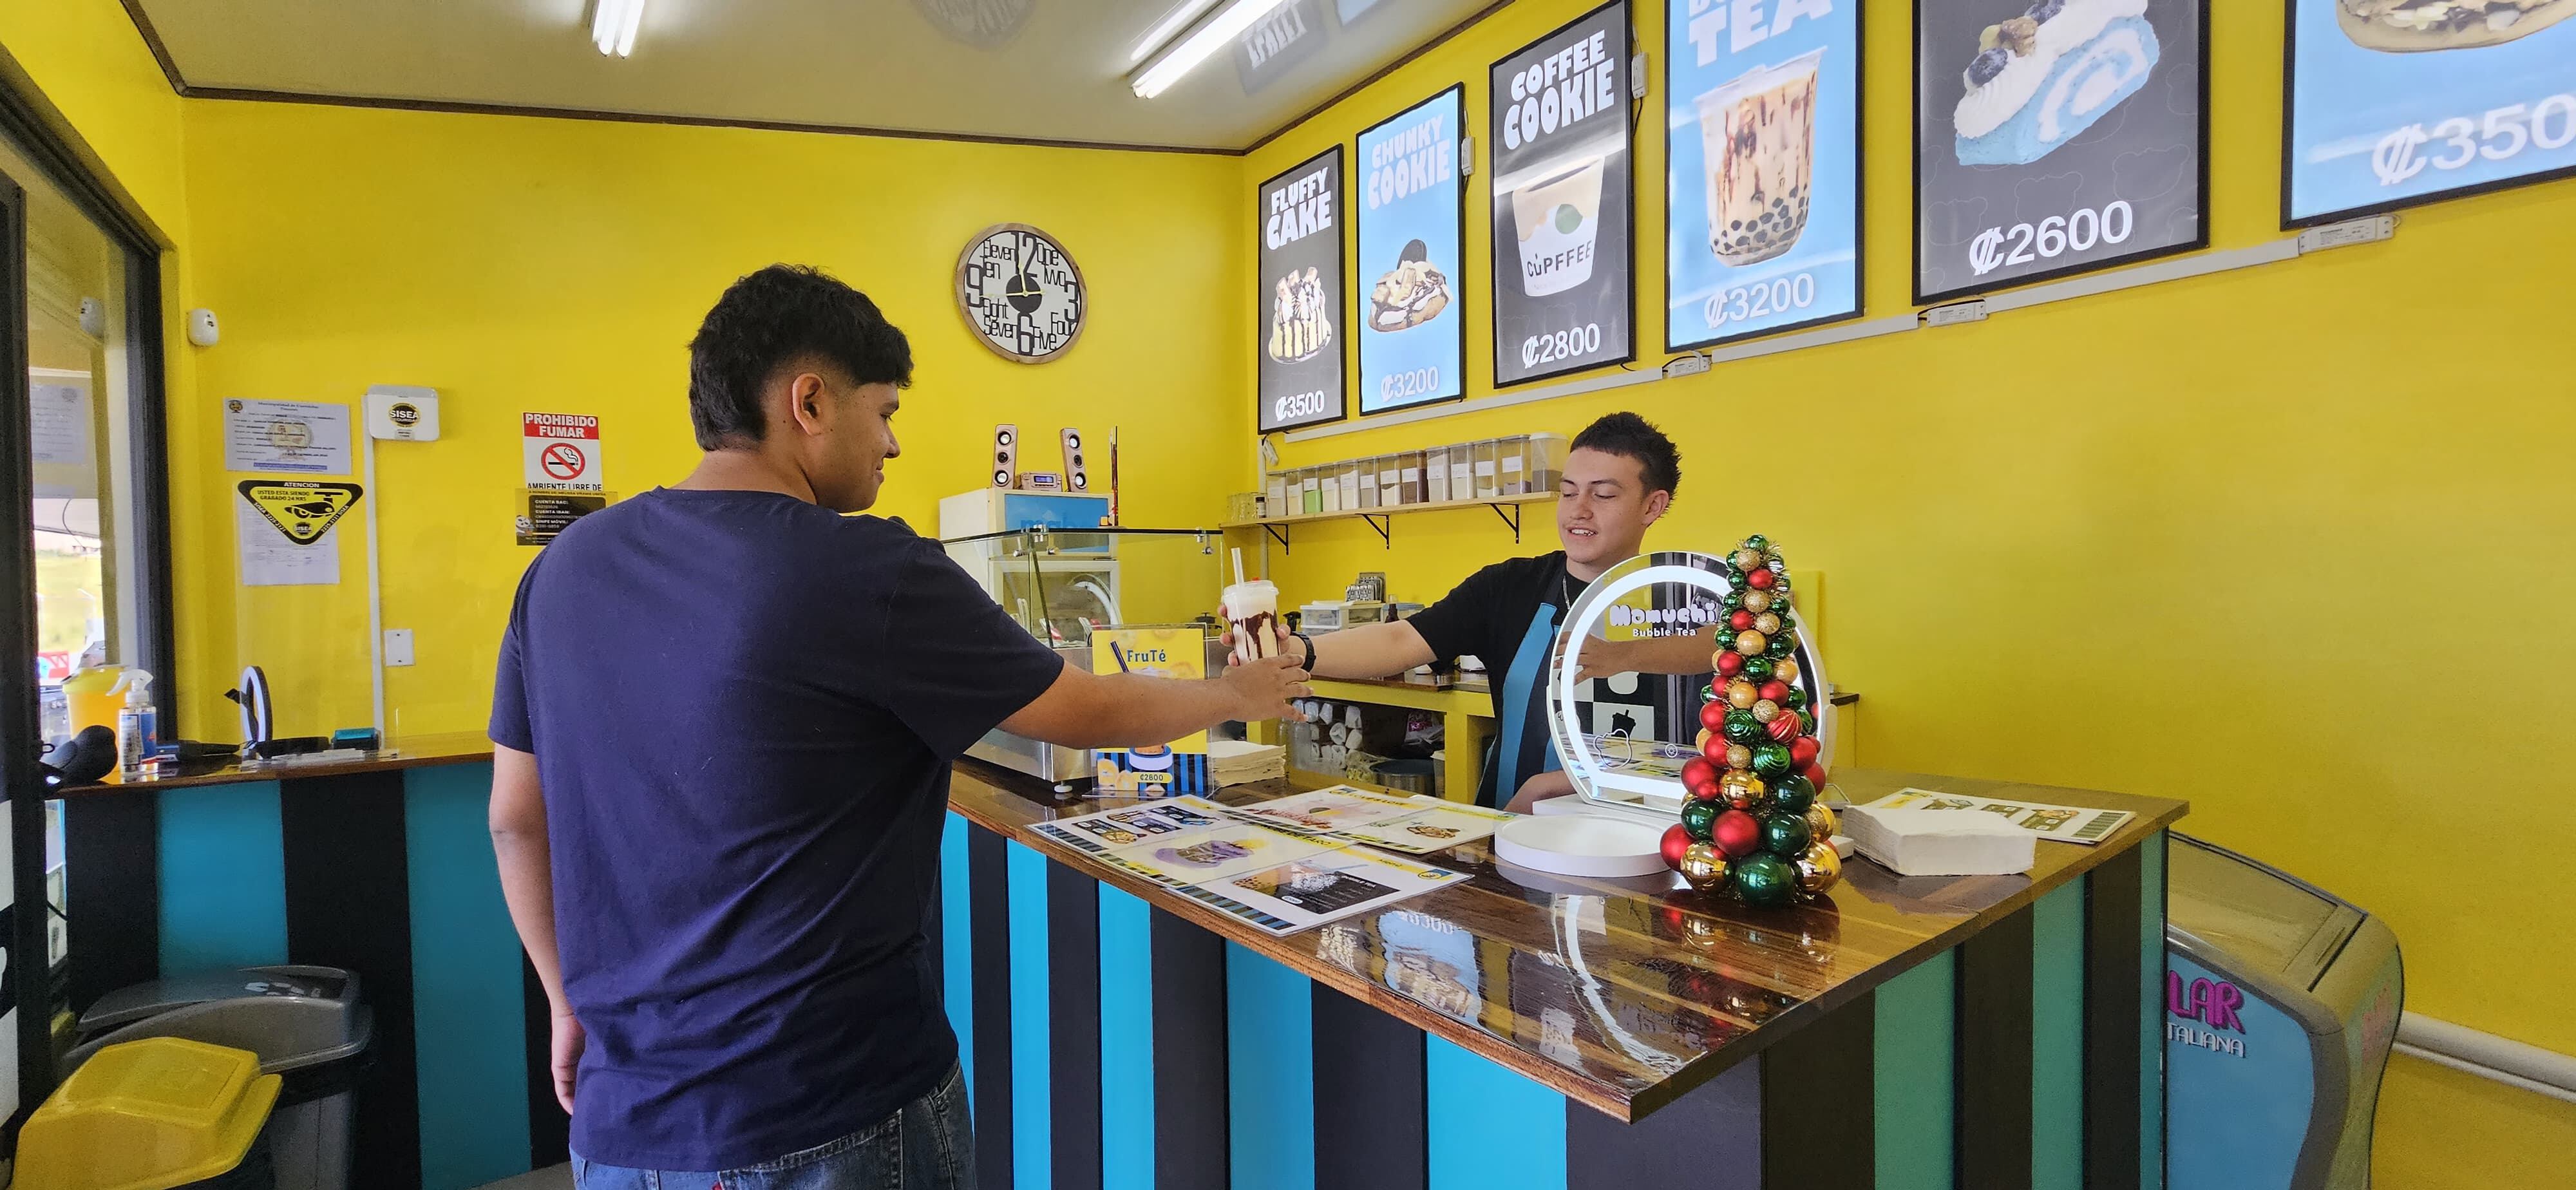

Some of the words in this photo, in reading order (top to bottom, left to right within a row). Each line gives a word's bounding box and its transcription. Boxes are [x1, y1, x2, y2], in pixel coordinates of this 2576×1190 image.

[1689, 0, 1833, 68] TEA
[1511, 30, 1605, 102] COFFEE
[1504, 59, 1615, 150] COOKIE
[1372, 113, 1443, 169] CHUNKY
[1271, 166, 1329, 214] FLUFFY
[1368, 138, 1450, 210] COOKIE
[1267, 191, 1331, 250] CAKE
[1011, 231, 1037, 278] 12
[1036, 242, 1059, 266] One
[966, 263, 983, 308] 9
[1064, 281, 1080, 323] 3
[1017, 312, 1034, 355] 6
[390, 410, 418, 419] SISEA
[525, 413, 596, 427] PROHIBIDO
[539, 425, 585, 438] FUMAR
[1633, 627, 1672, 637] Bubble
[1676, 627, 1697, 637] Tea
[1127, 649, 1166, 663] FruTé
[2167, 1022, 2246, 1051] TALIANA
